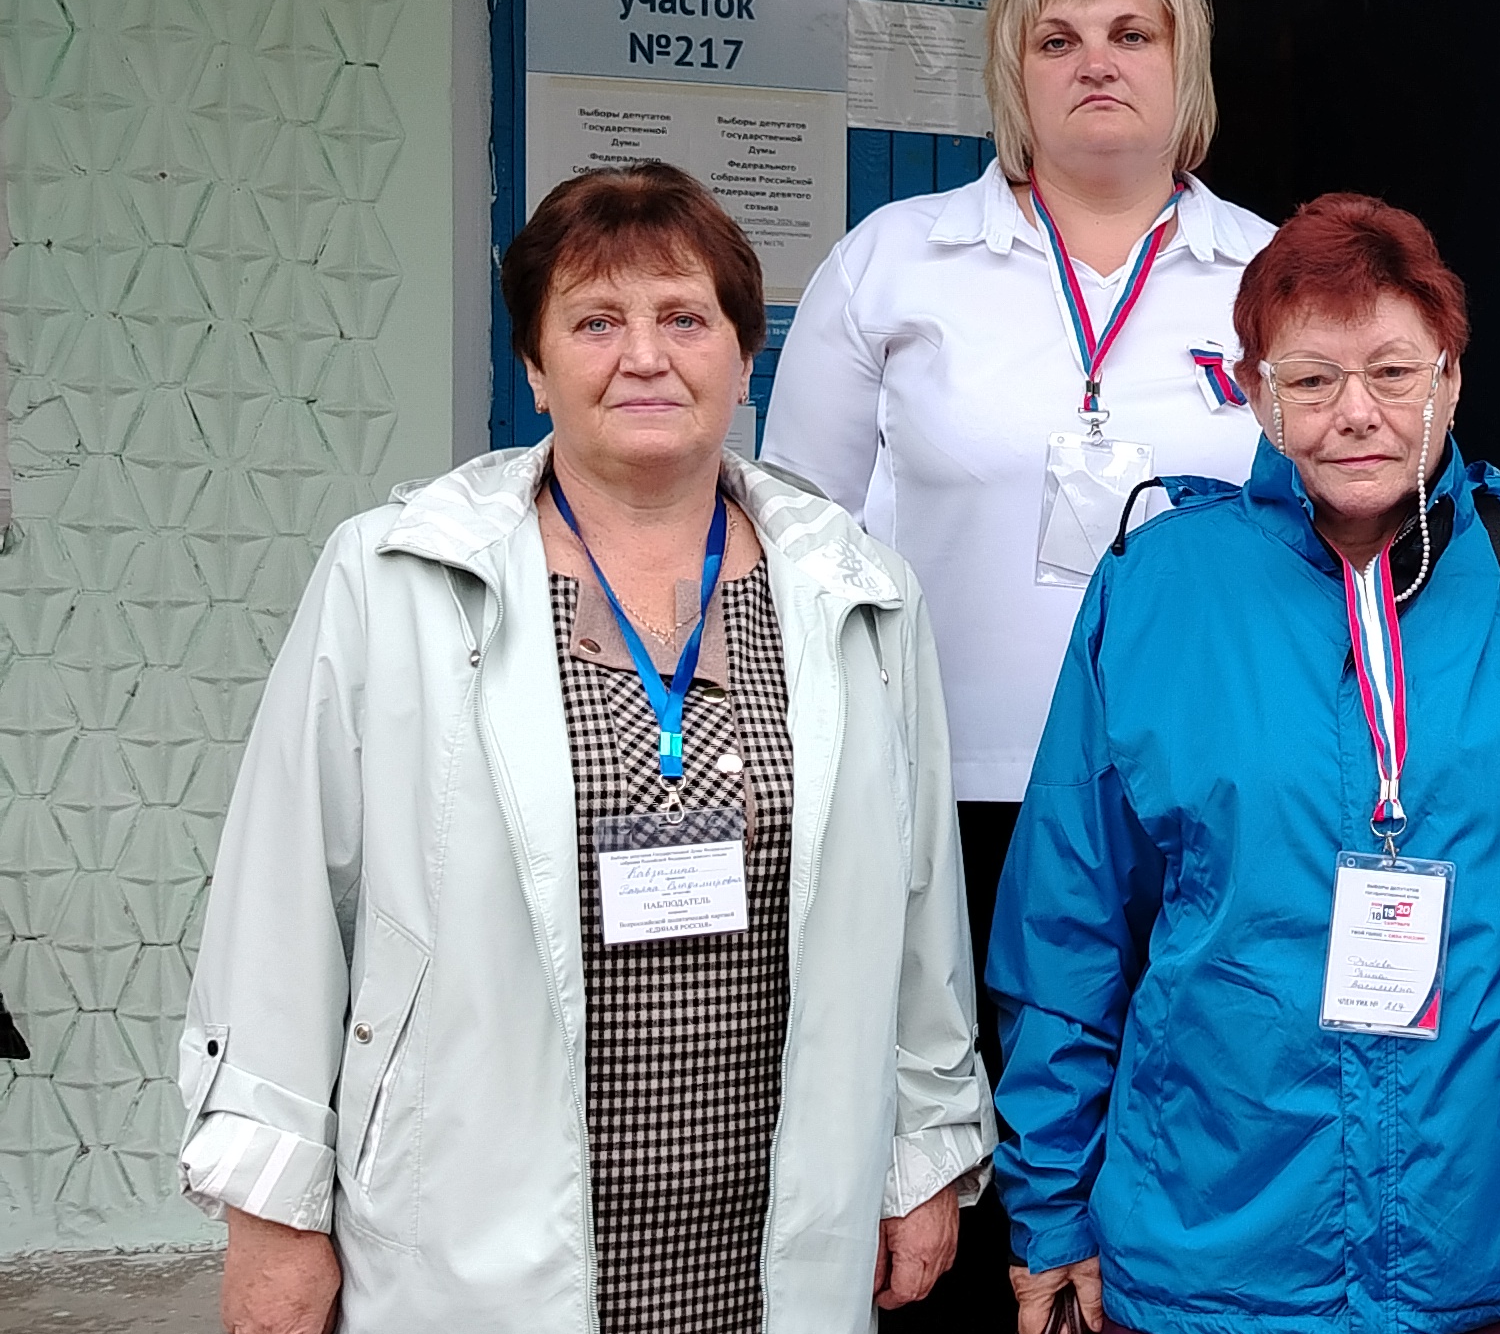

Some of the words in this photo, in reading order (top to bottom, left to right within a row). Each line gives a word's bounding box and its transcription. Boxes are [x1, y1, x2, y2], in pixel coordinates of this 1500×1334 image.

[629, 31, 744, 70] №217
[579, 108, 620, 119] Выборы
[622, 112, 671, 121] депутатов
[717, 116, 757, 127] Выборы
[759, 120, 806, 130] депутатов
[611, 138, 640, 148] Думы
[748, 146, 776, 156] Думы
[711, 173, 756, 183] Собрания
[759, 175, 813, 186] Российской
[745, 203, 779, 212] созыва
[643, 897, 711, 910] НАБЛЮДАТЕЛЬ
[1384, 908, 1395, 918] 19
[1396, 905, 1411, 915] 20
